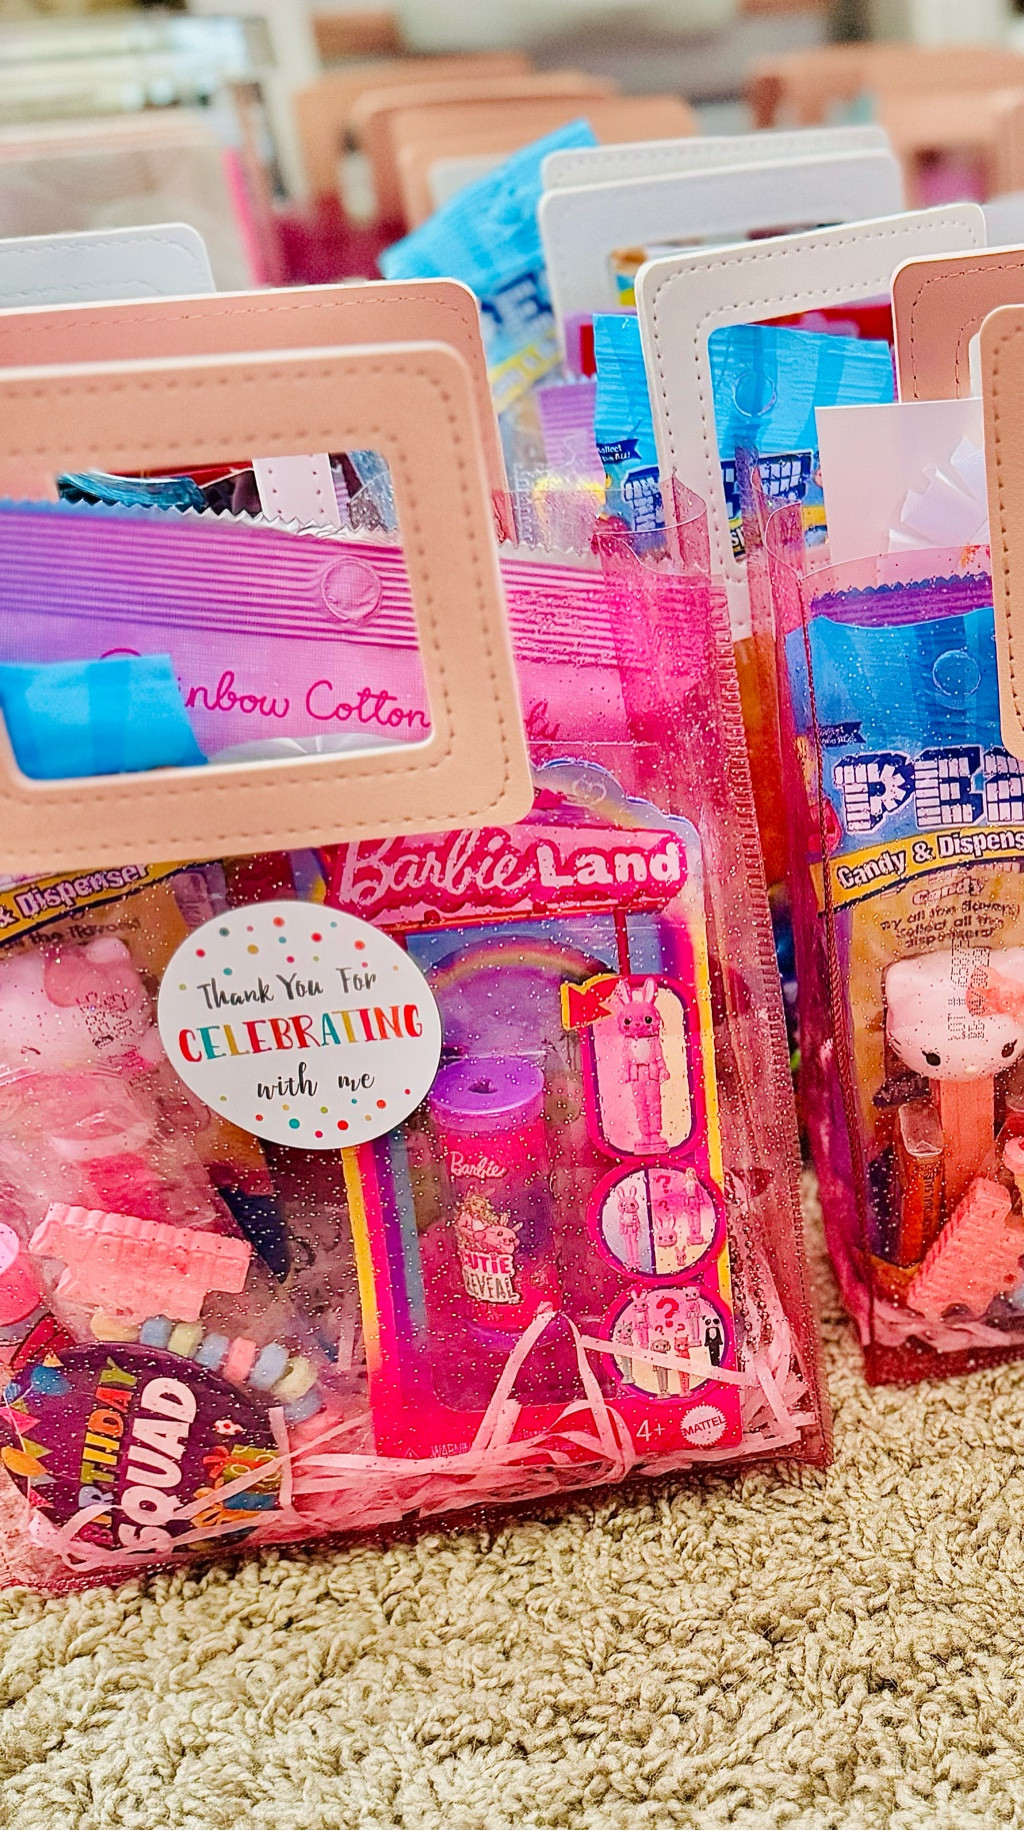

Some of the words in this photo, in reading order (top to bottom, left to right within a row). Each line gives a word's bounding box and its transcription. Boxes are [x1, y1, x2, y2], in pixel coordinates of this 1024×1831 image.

[305, 679, 431, 729] Cotton
[338, 829, 534, 905] Barbie
[535, 841, 681, 888] Land
[836, 849, 906, 890] Candy
[912, 841, 935, 863] &
[15, 863, 149, 919] Dispenser
[907, 911, 925, 924] all
[953, 916, 972, 928] all
[197, 977, 274, 1010] Thank
[276, 973, 324, 1000] You
[336, 967, 377, 993] For
[178, 1004, 423, 1063] CELEBRATING
[257, 1061, 318, 1100] with
[338, 1073, 375, 1091] me
[450, 1151, 508, 1178] Barbie
[462, 1269, 517, 1300] REVEAL
[70, 1356, 137, 1547] BIRTHDAY
[635, 1419, 665, 1442] 4+
[682, 1415, 725, 1438] MATTEL
[118, 1377, 197, 1556] SQUAD
